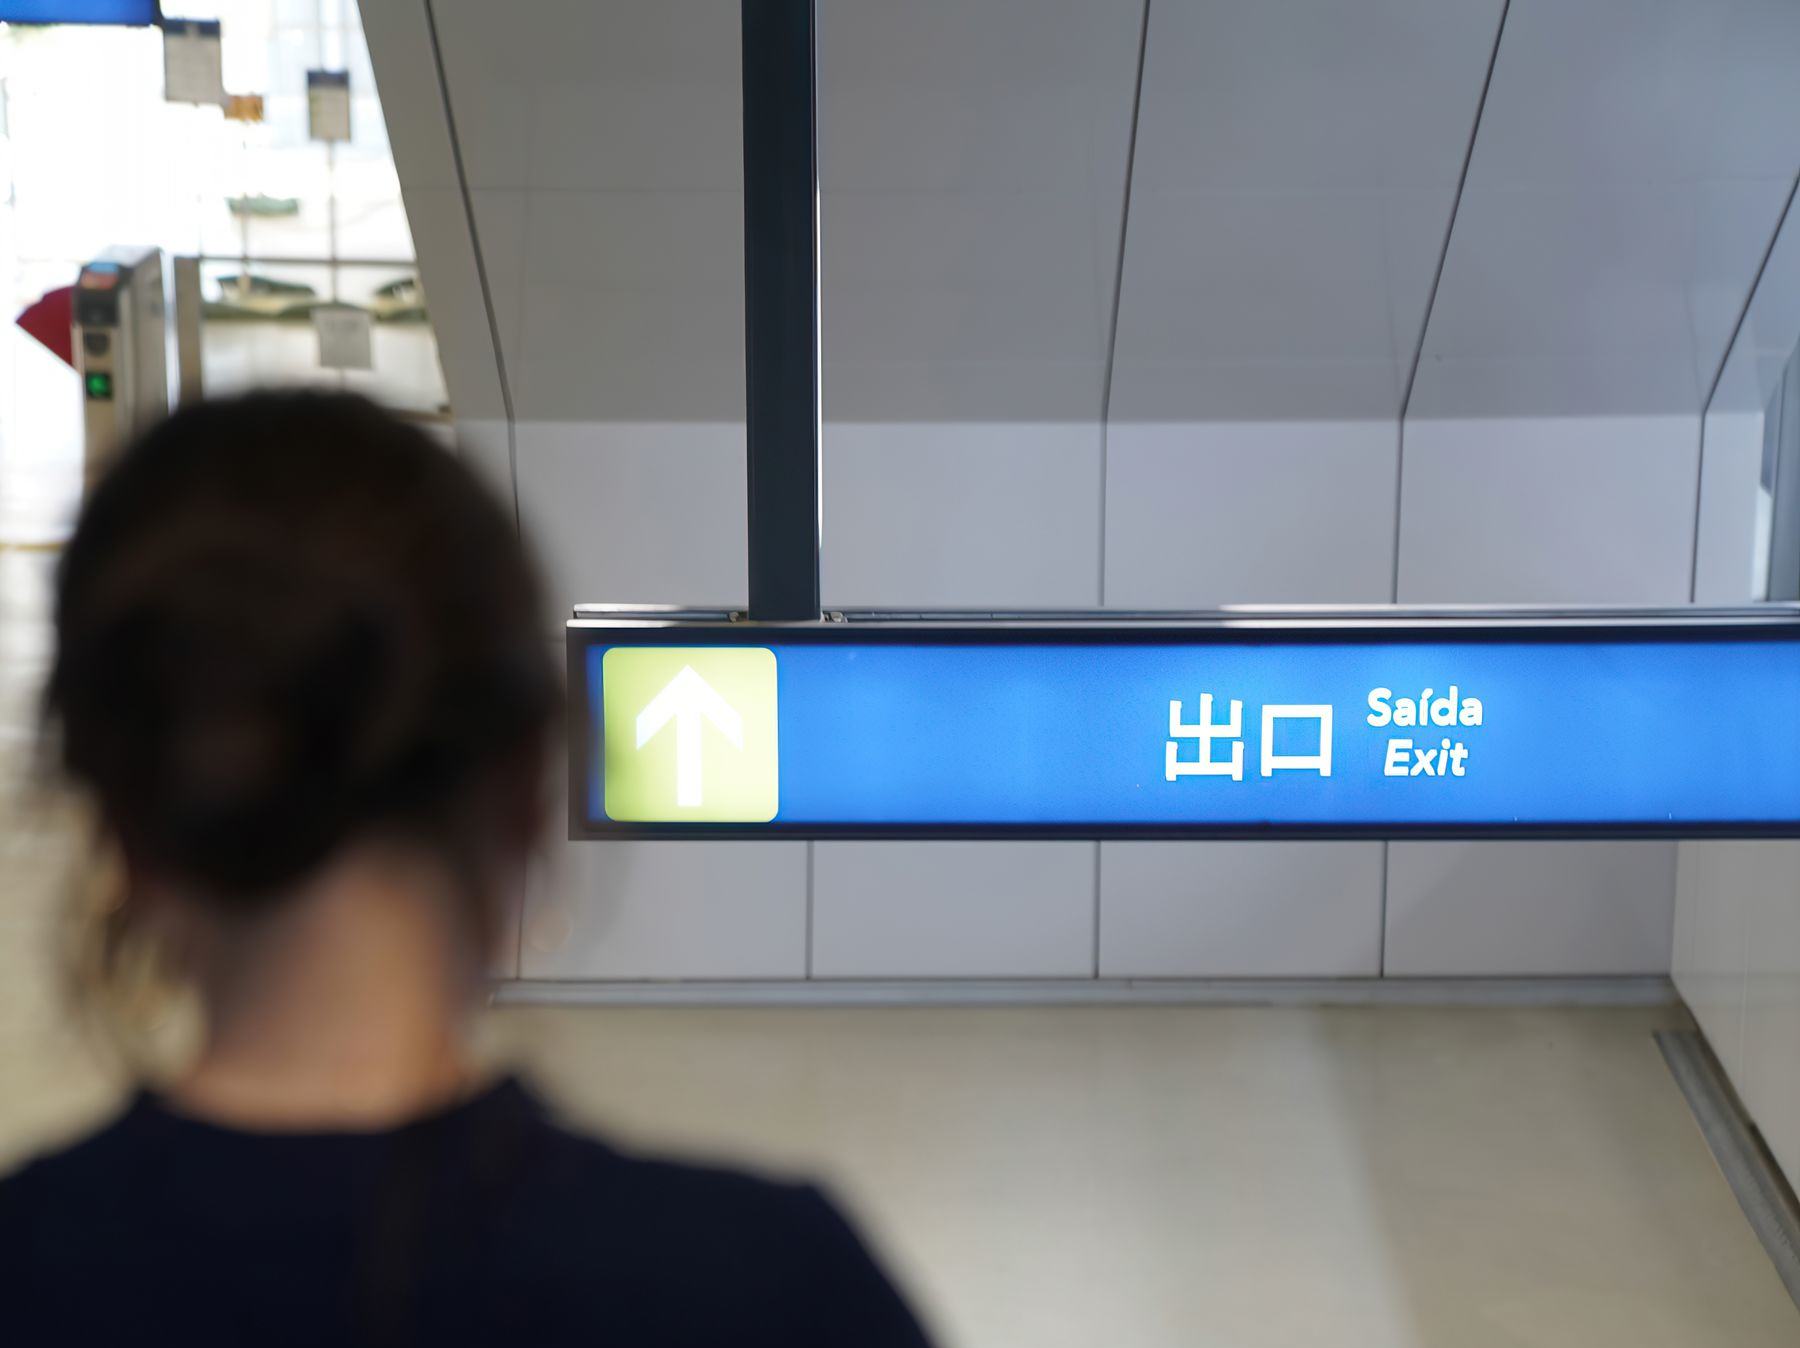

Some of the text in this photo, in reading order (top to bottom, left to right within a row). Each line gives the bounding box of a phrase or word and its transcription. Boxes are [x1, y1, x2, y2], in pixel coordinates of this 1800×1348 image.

[1366, 685, 1484, 728] Saída
[1165, 692, 1333, 781] 出口
[1383, 738, 1469, 778] Exit
